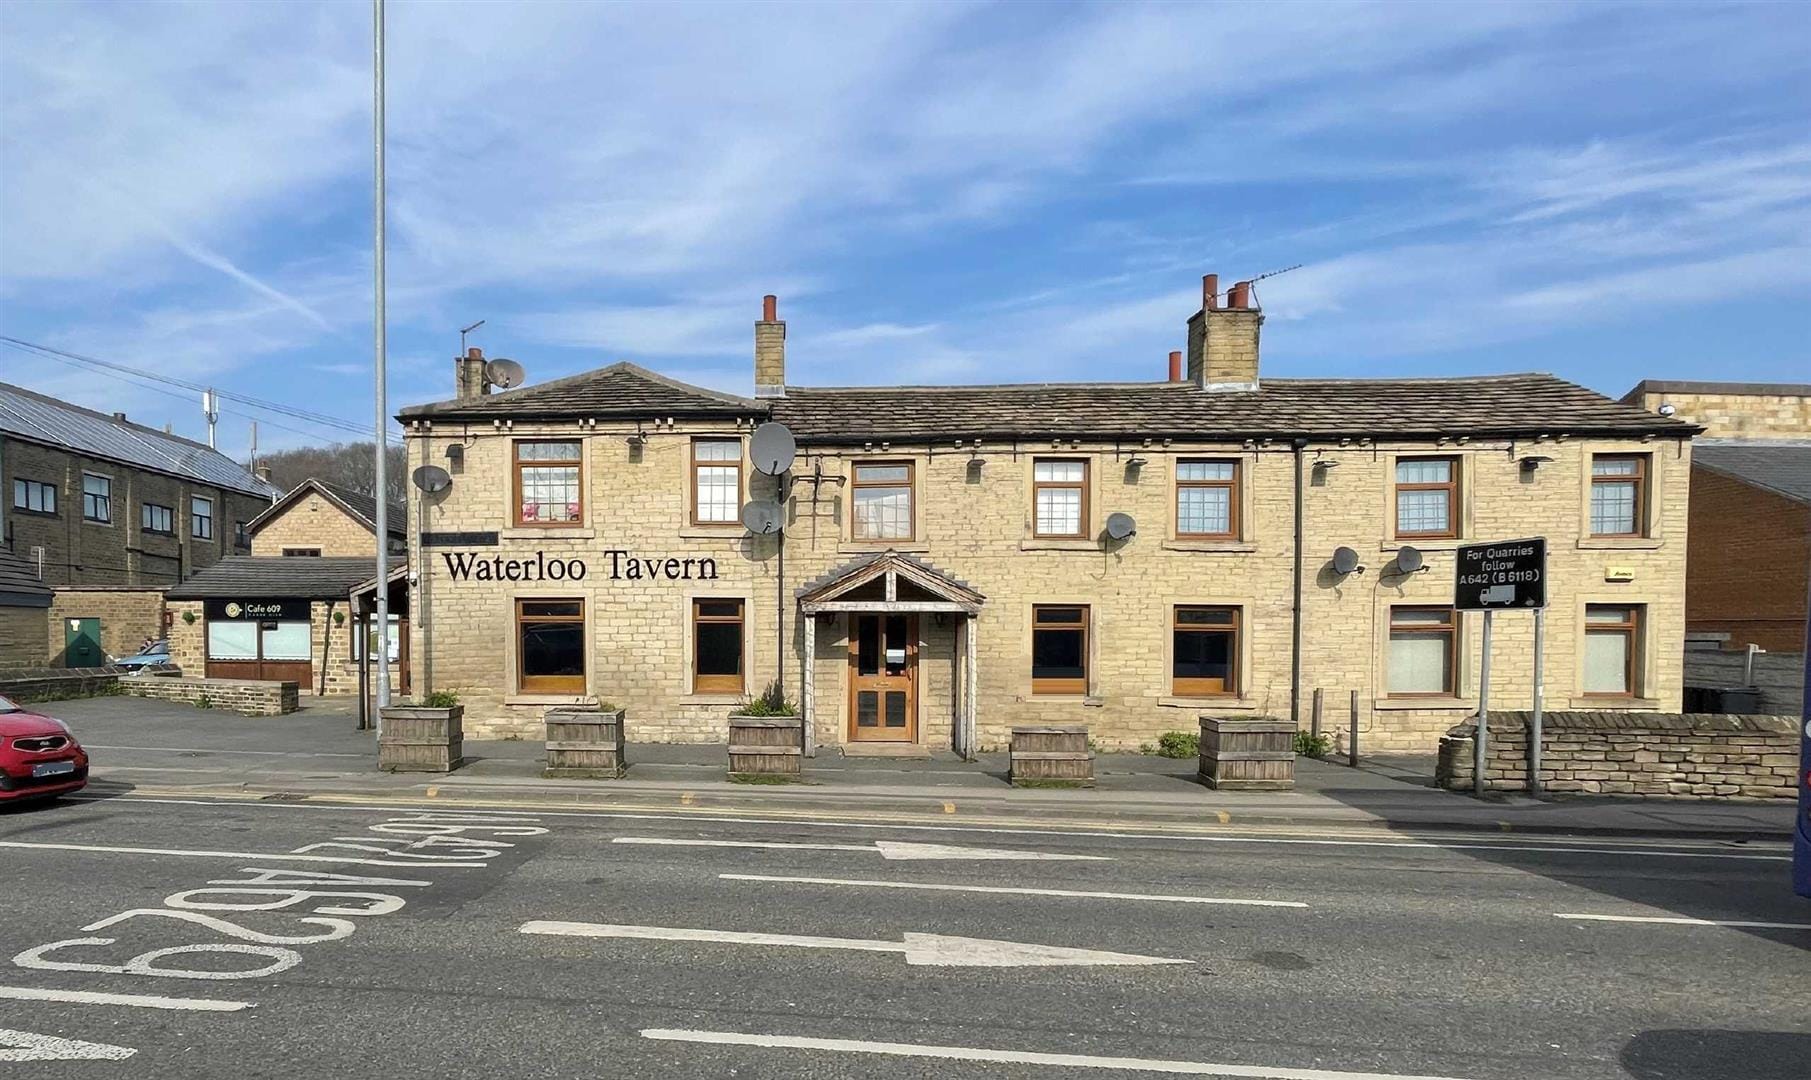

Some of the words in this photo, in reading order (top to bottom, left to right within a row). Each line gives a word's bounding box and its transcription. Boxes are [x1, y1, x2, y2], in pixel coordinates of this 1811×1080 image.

[1466, 550, 1483, 560] For
[1486, 546, 1534, 559] Quarries
[442, 550, 586, 581] Waterloo
[604, 550, 718, 580] Tavern
[1481, 560, 1515, 571] follow
[247, 604, 265, 613] Cafe
[266, 604, 281, 613] 609
[290, 812, 550, 860] A642
[11, 866, 433, 980] A629
